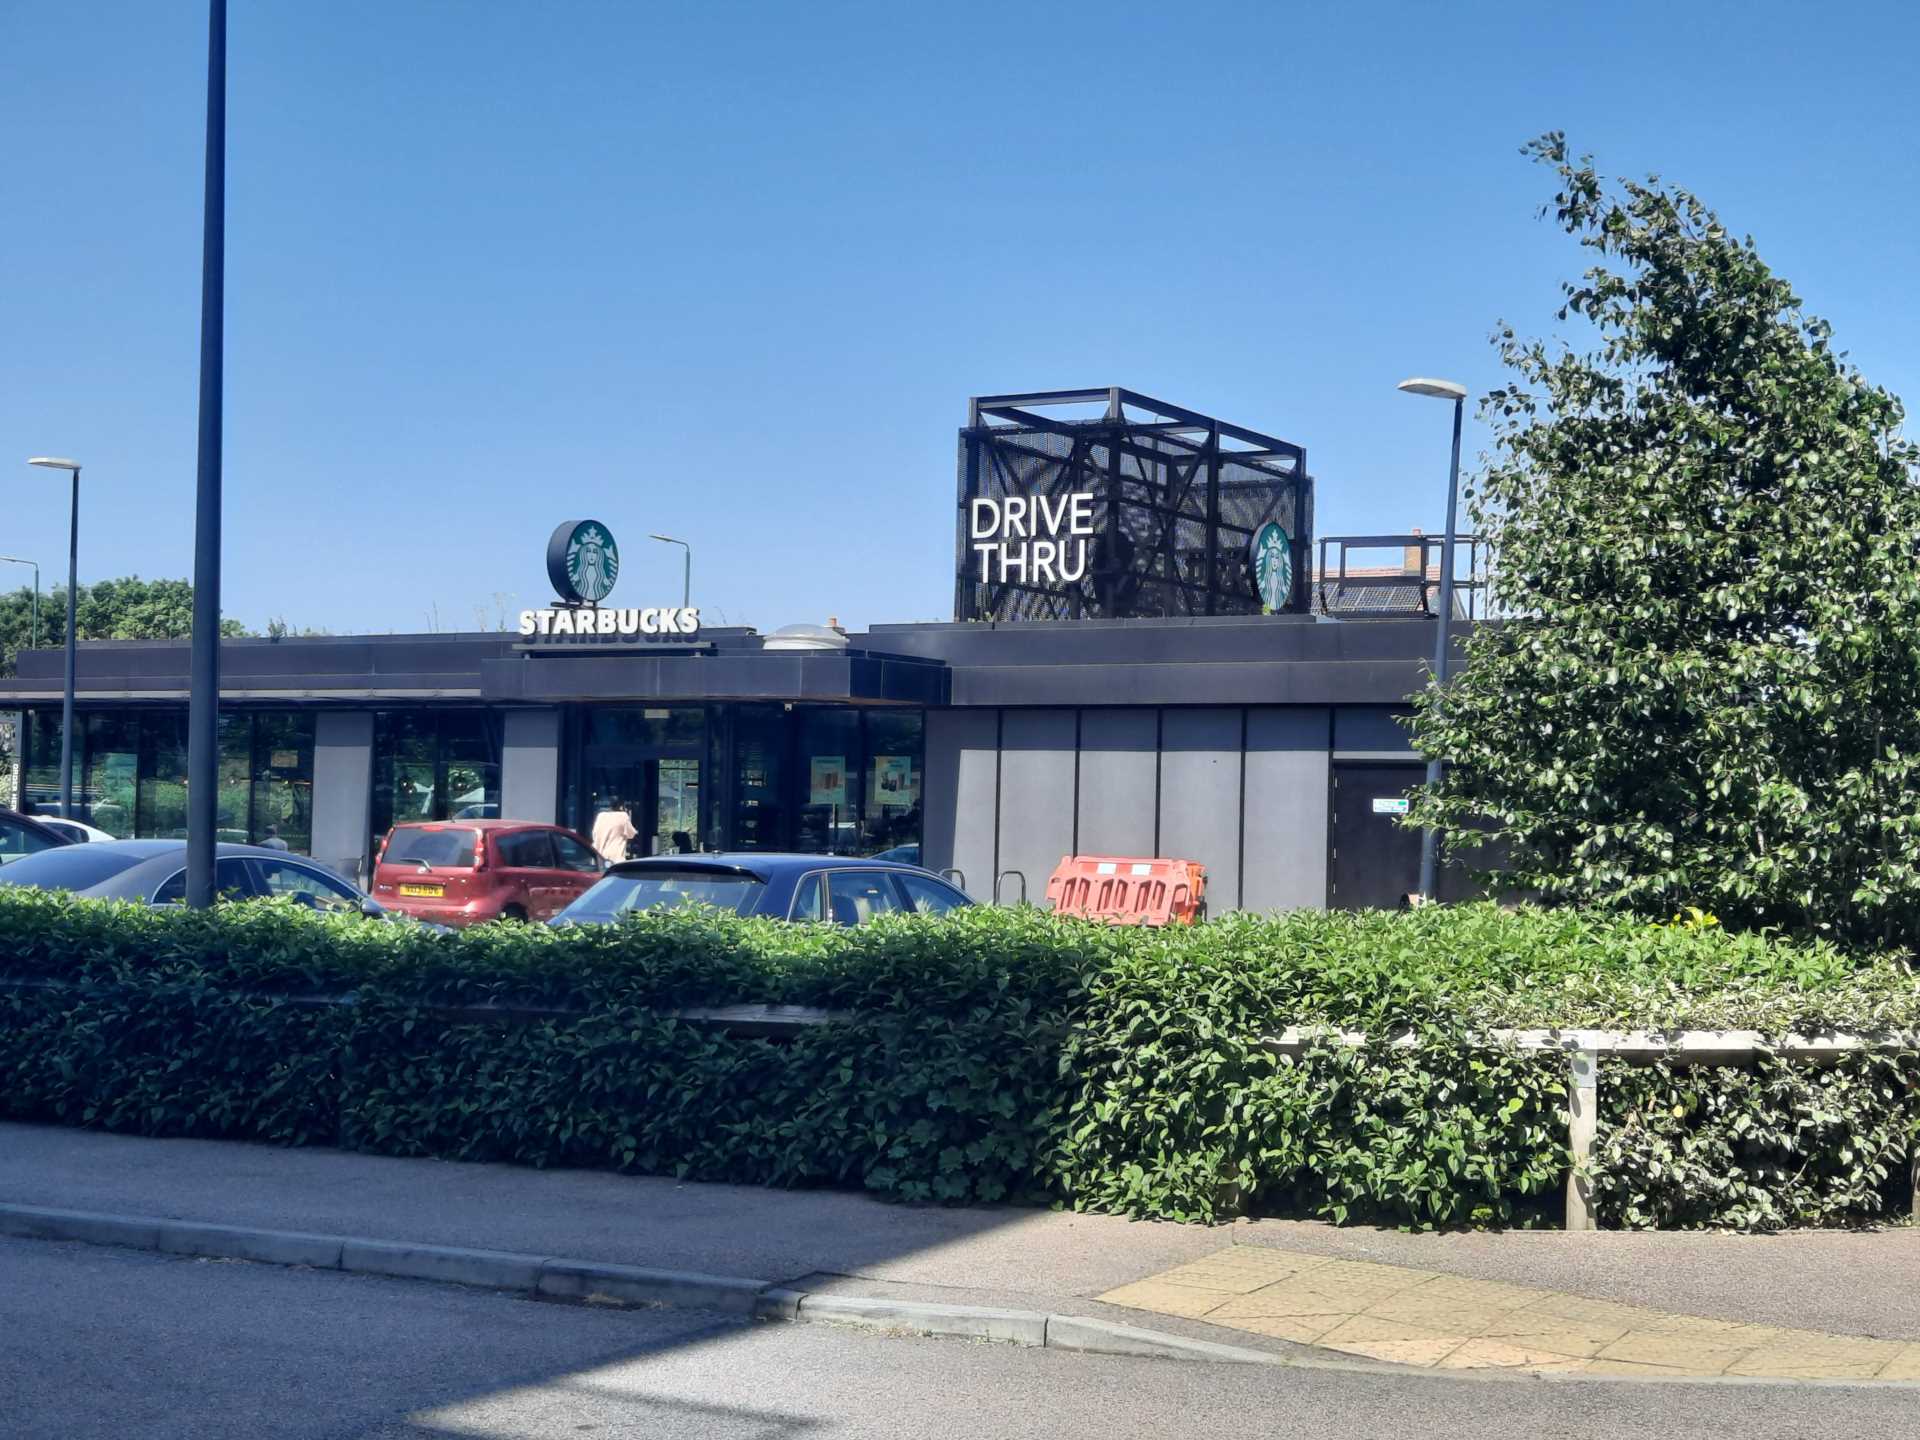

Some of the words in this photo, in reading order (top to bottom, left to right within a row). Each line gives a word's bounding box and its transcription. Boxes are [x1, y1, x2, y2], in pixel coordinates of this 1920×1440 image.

[971, 493, 1094, 539] DRIVE
[973, 539, 1086, 584] THRU
[519, 607, 700, 636] STARBUCKS
